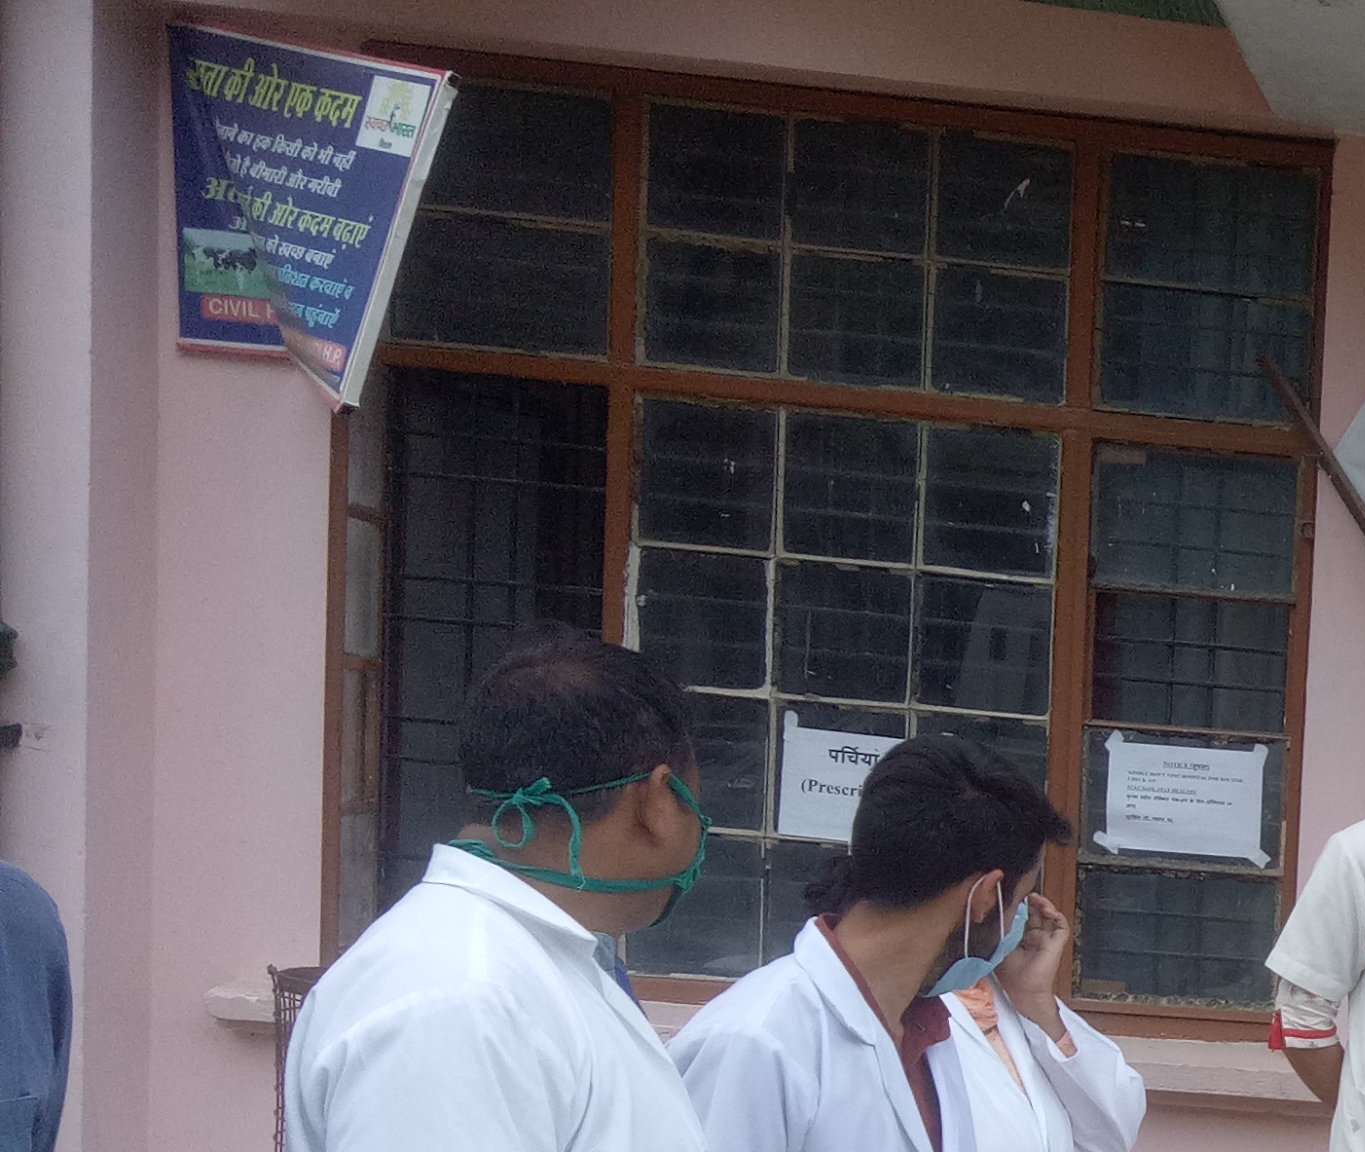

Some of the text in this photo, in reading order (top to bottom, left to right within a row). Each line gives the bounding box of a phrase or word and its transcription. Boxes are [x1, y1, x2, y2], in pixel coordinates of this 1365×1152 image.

[225, 57, 255, 103] की
[250, 63, 288, 112] ओर
[284, 82, 317, 118] एक
[315, 88, 363, 128] कदम
[208, 297, 261, 319] CIVIL
[801, 778, 863, 798] (Prescri
